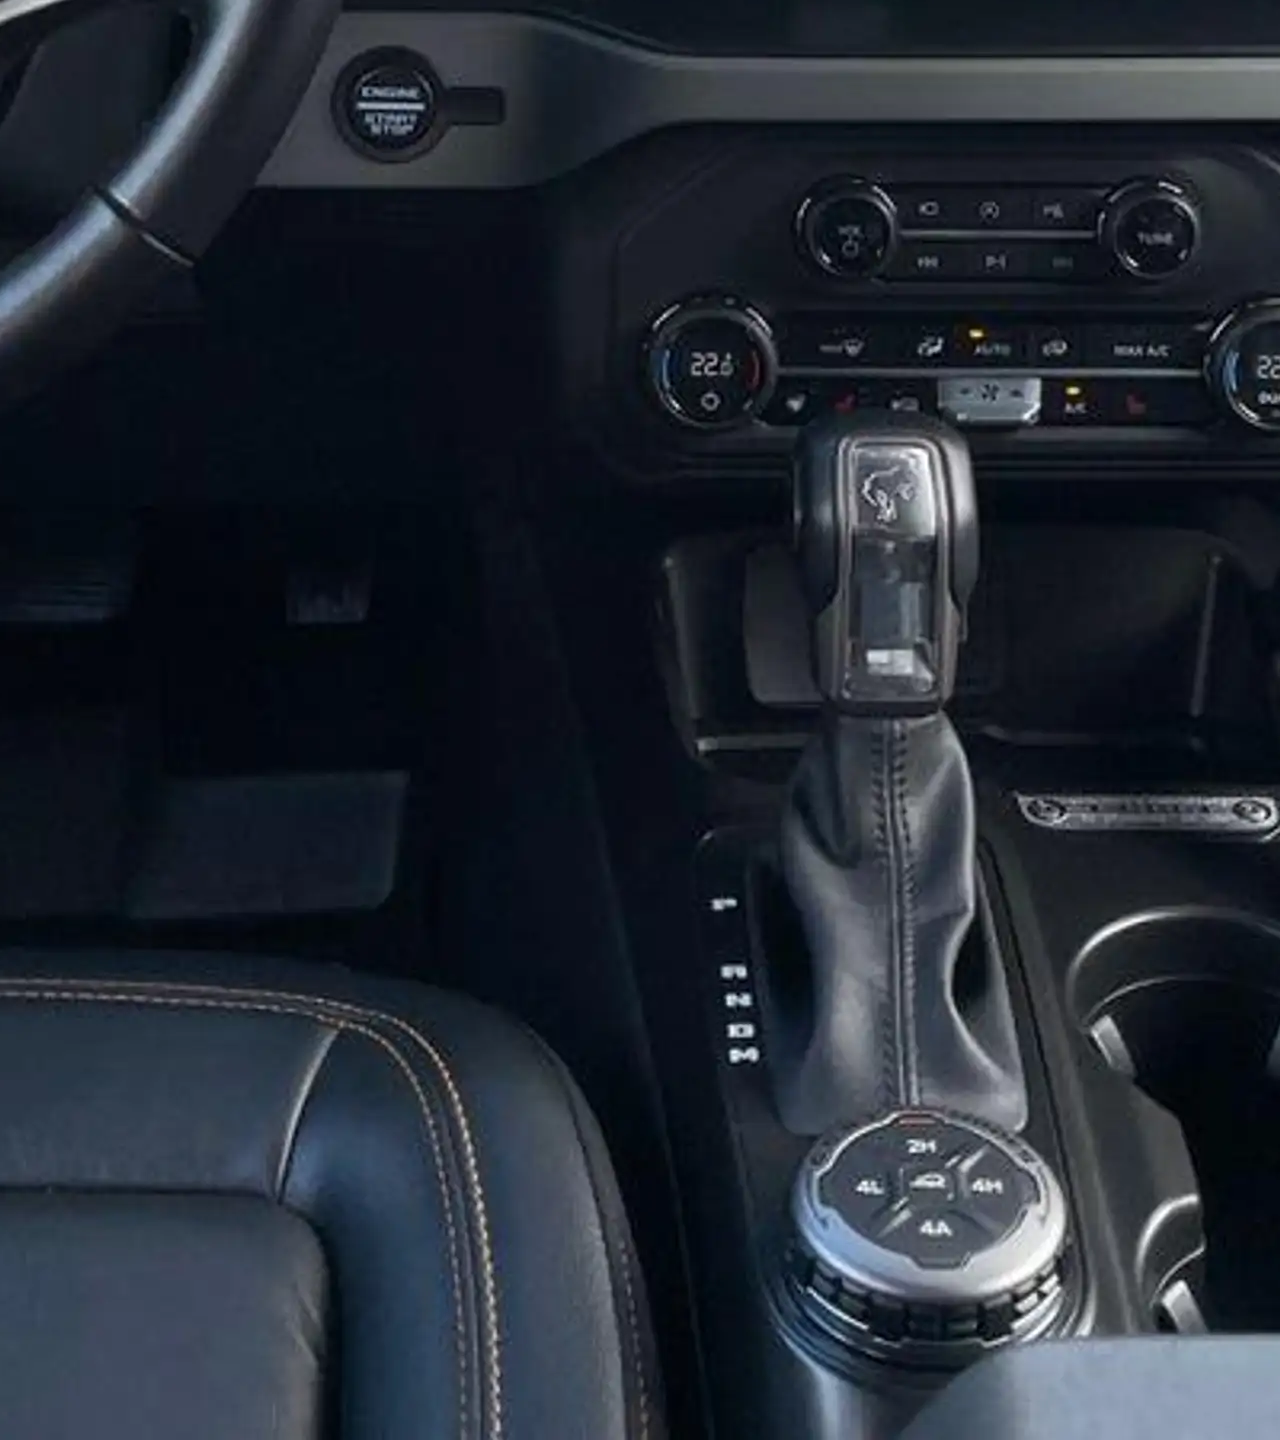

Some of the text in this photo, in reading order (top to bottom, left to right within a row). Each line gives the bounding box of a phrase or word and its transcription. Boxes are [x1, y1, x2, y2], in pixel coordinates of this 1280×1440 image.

[361, 86, 420, 98] ENGINE
[364, 112, 418, 125] START
[369, 124, 415, 136] STOP
[905, 1138, 937, 1154] 2H
[855, 1179, 885, 1195] 4L
[971, 1177, 1004, 1194] 4H
[919, 1220, 953, 1237] 4A
